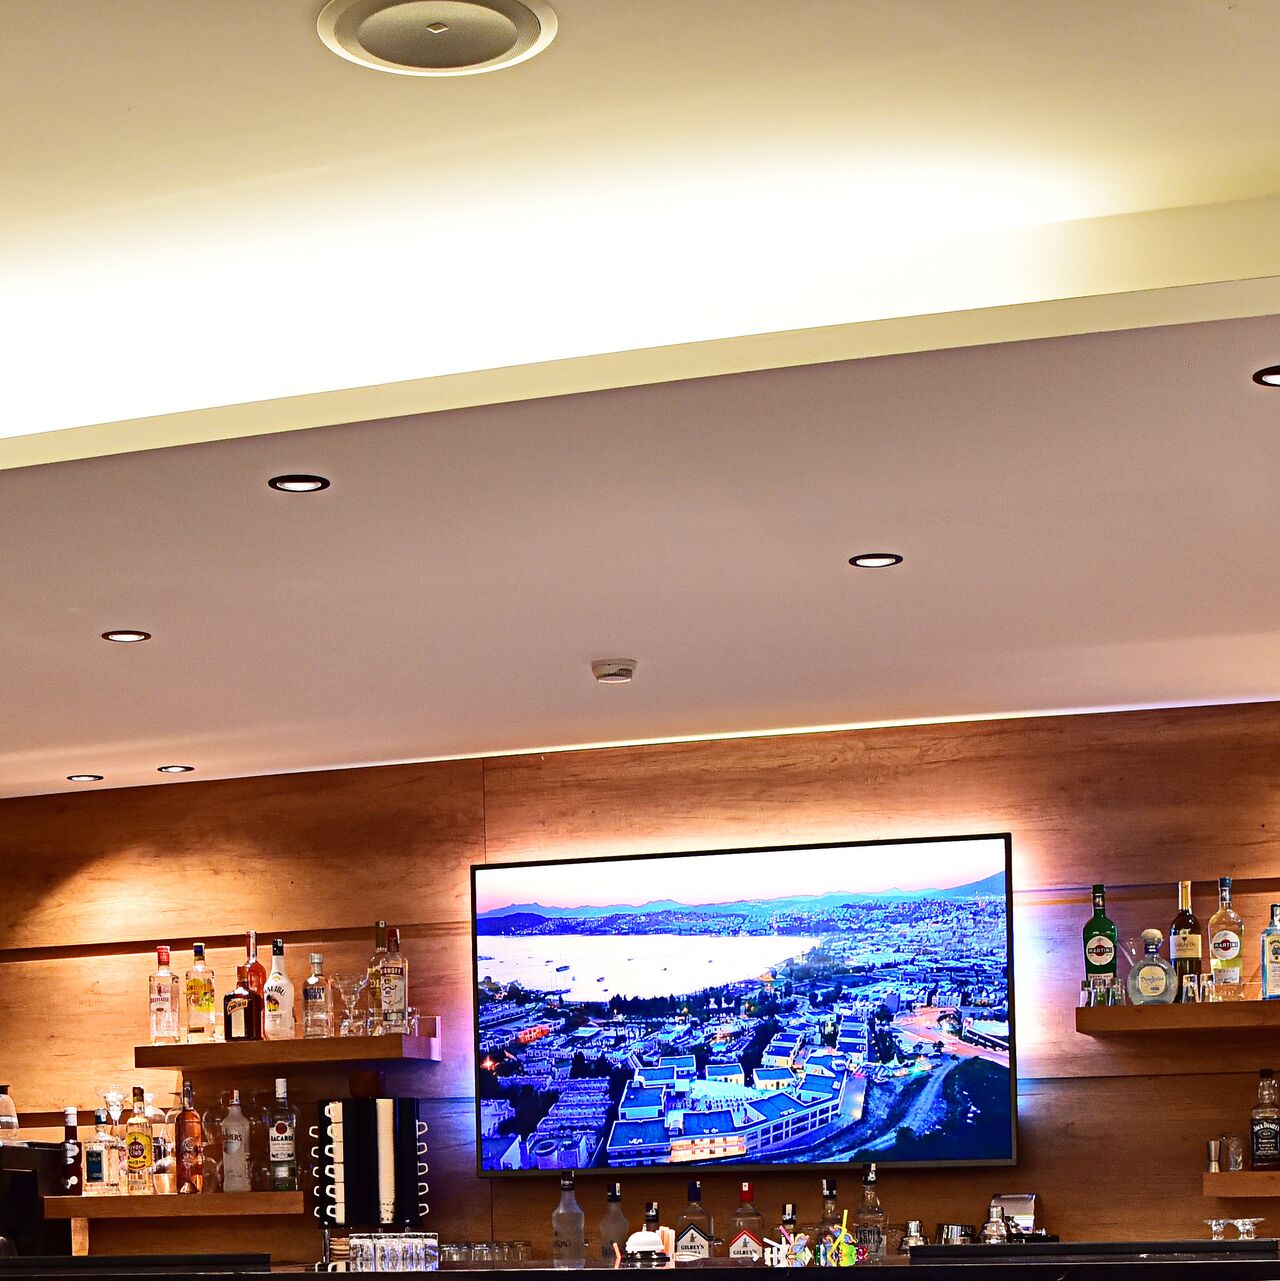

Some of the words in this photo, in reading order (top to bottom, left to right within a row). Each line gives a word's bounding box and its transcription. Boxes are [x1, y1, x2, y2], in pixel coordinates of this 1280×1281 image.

[1088, 946, 1112, 954] MARTINI
[264, 984, 287, 997] MALIBU
[1253, 1122, 1264, 1132] JACK
